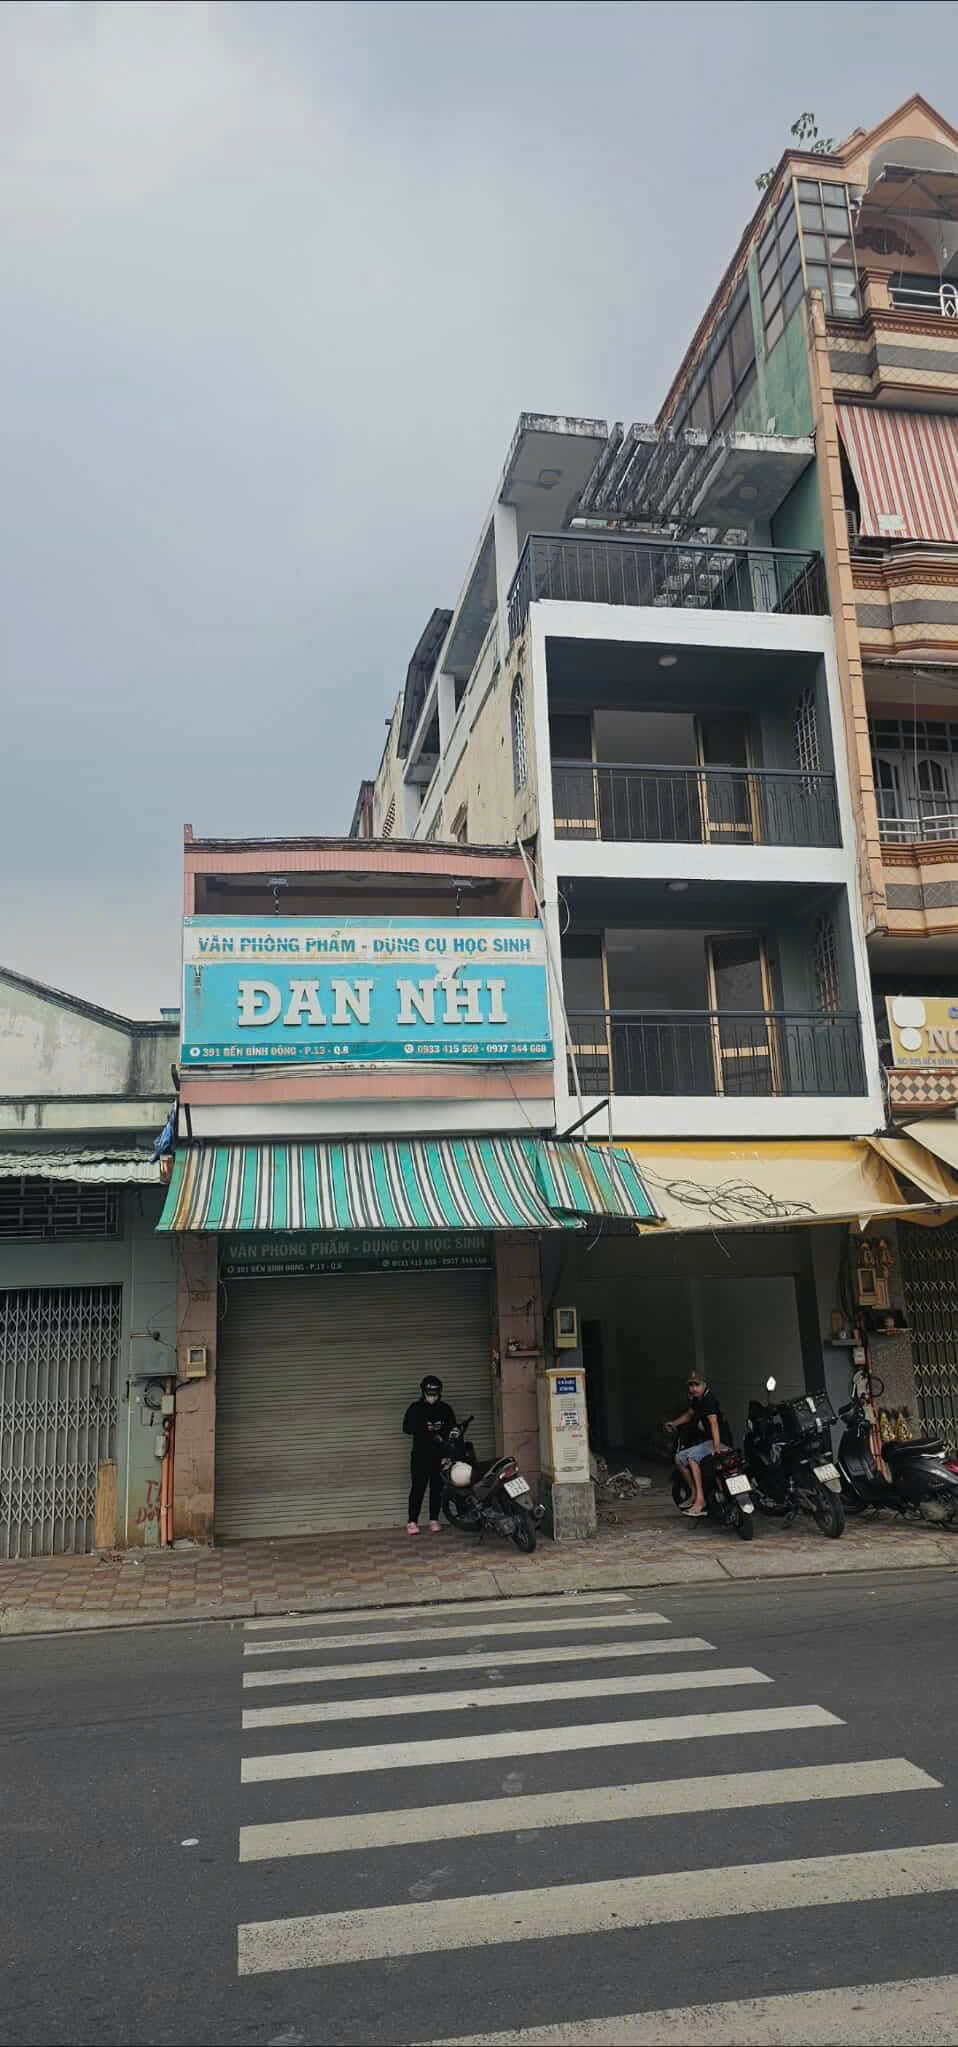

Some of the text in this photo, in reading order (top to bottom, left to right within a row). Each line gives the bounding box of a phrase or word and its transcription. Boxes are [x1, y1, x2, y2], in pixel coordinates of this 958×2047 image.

[305, 930, 356, 952] PHẨM
[425, 938, 447, 955] CỤ
[453, 938, 487, 955] HỌC
[493, 938, 531, 952] SINH
[237, 979, 508, 1027] ĐAN NHI
